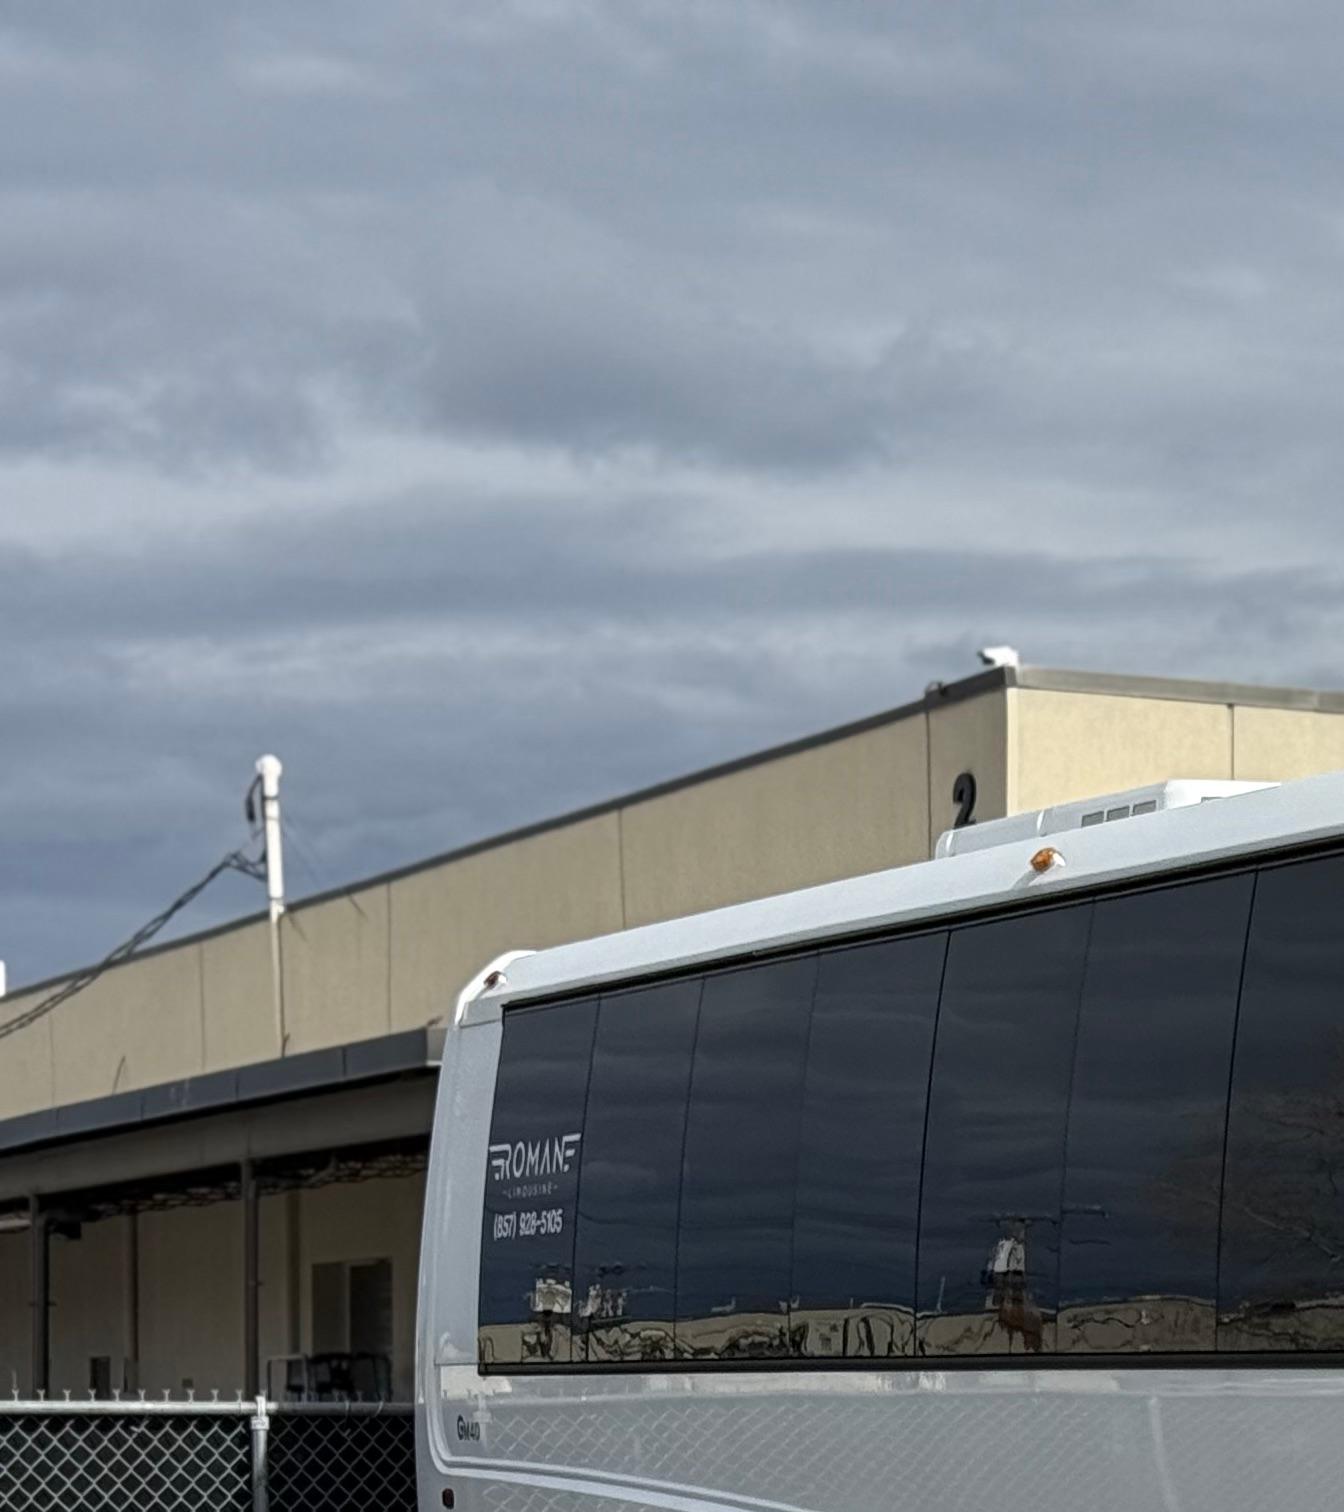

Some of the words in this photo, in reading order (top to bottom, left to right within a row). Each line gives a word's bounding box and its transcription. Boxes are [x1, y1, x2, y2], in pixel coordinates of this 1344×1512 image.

[953, 773, 976, 829] 2
[490, 1133, 581, 1180] ROMAN
[494, 1211, 516, 1240] (857)
[519, 1208, 563, 1236] 928-5105
